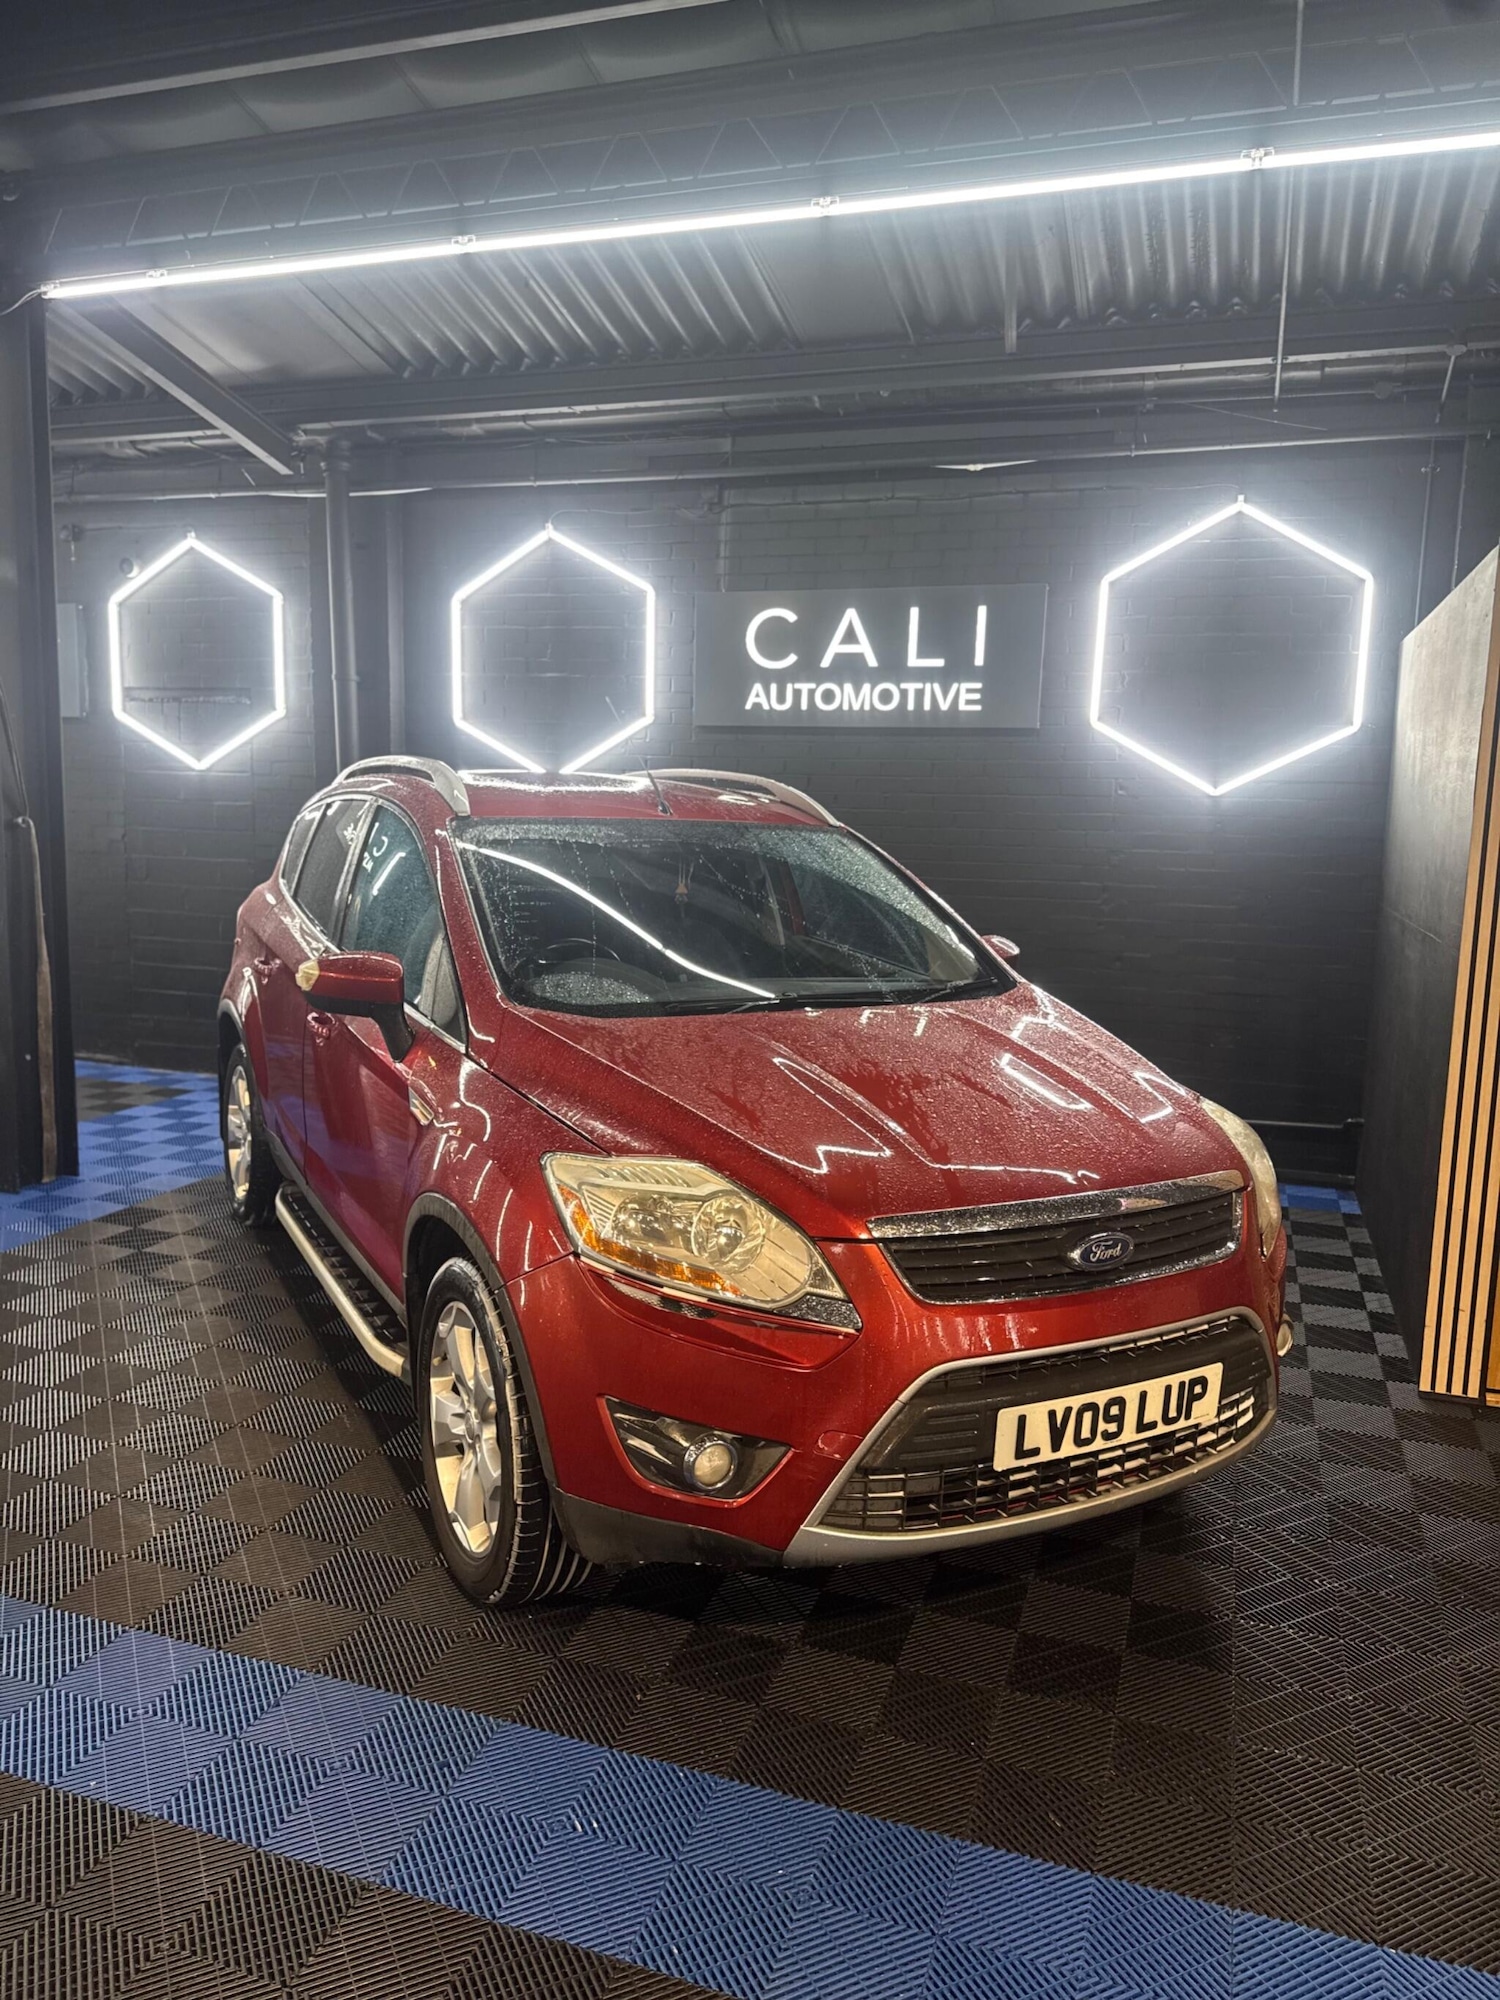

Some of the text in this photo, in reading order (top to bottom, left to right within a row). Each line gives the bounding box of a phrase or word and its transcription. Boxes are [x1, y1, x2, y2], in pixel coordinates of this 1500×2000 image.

[745, 605, 987, 669] CALI
[745, 682, 983, 712] AUTOMOTIVE
[1089, 1240, 1122, 1262] Ford
[1014, 1375, 1209, 1461] LV09 LUP
